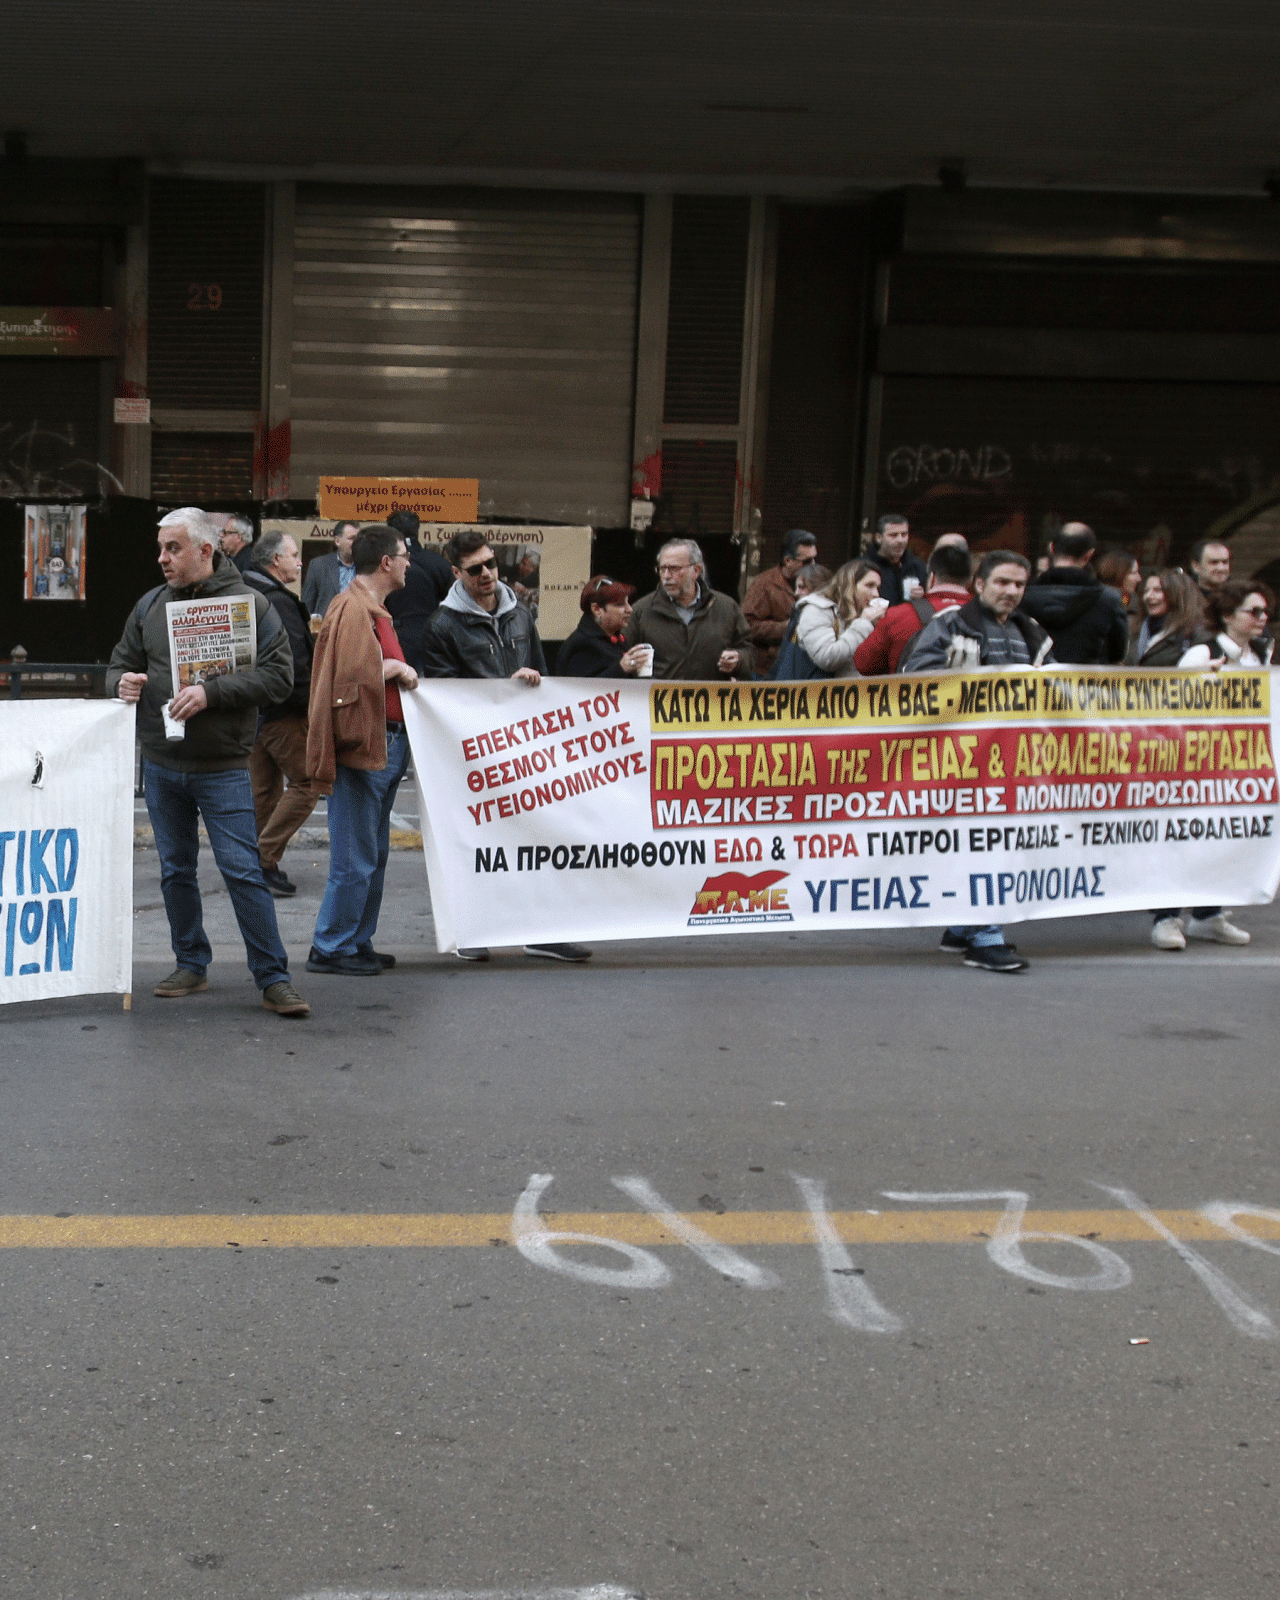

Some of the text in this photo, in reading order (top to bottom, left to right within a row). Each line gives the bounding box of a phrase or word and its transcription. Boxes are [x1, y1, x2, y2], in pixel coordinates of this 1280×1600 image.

[187, 283, 222, 310] 29
[325, 484, 389, 497] Υπουργείο
[392, 484, 446, 497] Εργασίας
[356, 500, 442, 513] μέχρι θανάτου
[172, 614, 229, 626] αλληλεγγυη
[187, 603, 228, 615] εργατικη
[654, 688, 710, 724] ΚΑΤΩ
[719, 687, 743, 722] ΤΑ
[749, 686, 810, 721] ΧΕΡΙΑ
[816, 684, 859, 719] ΑΠΟ
[867, 683, 893, 717] ΤΑ
[898, 683, 940, 716] ΒΑΕ
[958, 678, 1038, 713] ΜΕΙΩΣΗ
[1043, 678, 1073, 711] ΤΩΝ
[1077, 678, 1120, 711] ΟΡΙΩΝ
[1125, 677, 1262, 710] ΣΥΝΤΑΞΙΟΔΟΤΗΣΗΣ
[461, 690, 622, 762] ΕΠΕΚΤΑΣΗ ΤΟΥ
[467, 721, 635, 793] ΘΕΣΜΟΥ ΣΤΟΥΣ
[655, 728, 1275, 791] ΠΡΟΣΤΑΣΙΑ ΤΗΣ ΥΓΕΙΑΣ & ΑΣΦΑΛΕΙΑΣ ΣΤΗΝ ΕΡΓΑΣΙΑ
[467, 751, 647, 827] ΥΓΕΙΟΝΟΜΙΚΟΥΣ
[657, 776, 1275, 828] ΜΑΖΙΚΕΣ ΠΡΟΣΛΗΨΕΙΣ ΜΟΝΙΜΟΥ ΠΡΟΣΩΠΙΚΟΥ
[475, 846, 508, 873] ΝΑ
[517, 839, 706, 871] ΠΡΟΣΛΗΦΘΟΥΝ
[714, 837, 763, 863] ΕΔΩ
[771, 836, 786, 861] &
[793, 833, 859, 860] ΤΩΡΑ
[867, 828, 960, 856] ΓΙΑΤΡΟΙ
[969, 824, 1060, 852] ΕΡΓΑΣΙΑΣ
[1081, 818, 1159, 847] ΤΕΧΝΙΚΟΙ
[1164, 815, 1274, 841] ΑΣΦΑΛΕΙΑΣ
[803, 874, 930, 914] ΥΓΕΙΑΣ
[969, 865, 1107, 907] ΠΡΟΝΟΙΑΣ
